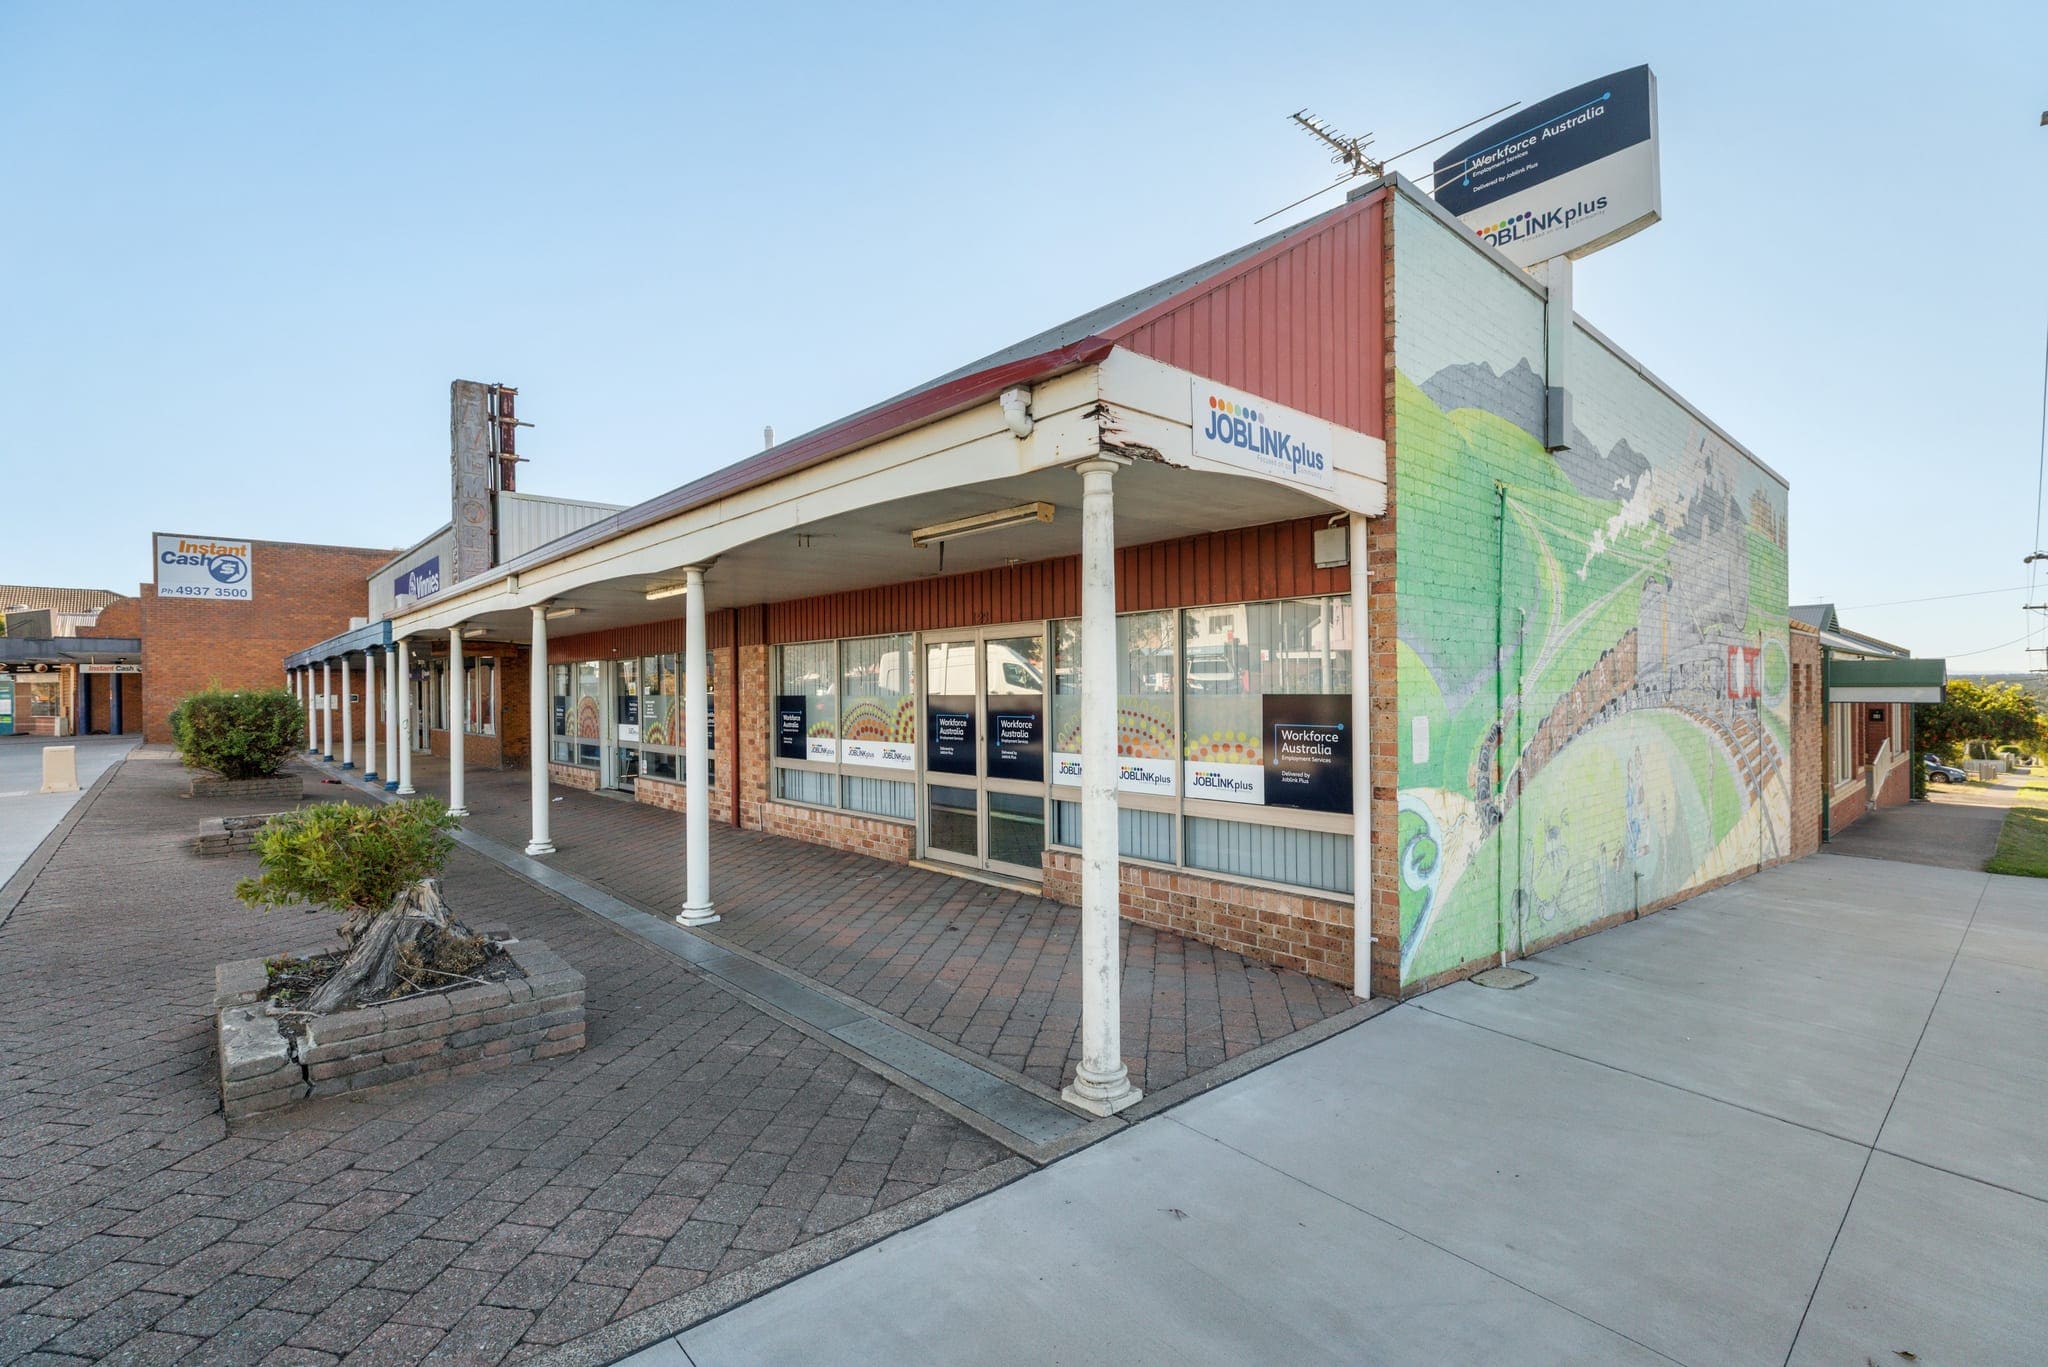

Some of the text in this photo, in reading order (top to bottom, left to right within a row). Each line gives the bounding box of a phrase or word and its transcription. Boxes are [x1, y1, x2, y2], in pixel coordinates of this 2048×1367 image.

[1472, 105, 1605, 169] Workforce Australia
[1472, 150, 1529, 177] Employment Services
[1472, 178, 1498, 193] Delivered
[1526, 162, 1539, 171] Plus
[1204, 410, 1324, 475] JOBLINKplus
[178, 539, 247, 557] Instant
[160, 550, 212, 567] Cash
[415, 569, 439, 599] Vinnies
[161, 586, 248, 598] Ph 4937 3500
[939, 718, 967, 727] Workforce
[1000, 719, 1033, 729] Workforce
[939, 727, 964, 736] Australia
[1001, 729, 1029, 739] Australia
[1281, 729, 1339, 743] Workforce
[1281, 742, 1332, 755] Australia
[1281, 755, 1311, 763] Employment
[1118, 770, 1171, 786] JOBLINKplus
[1281, 770, 1303, 778] Delivered
[1192, 776, 1254, 793] JOBLINKplus
